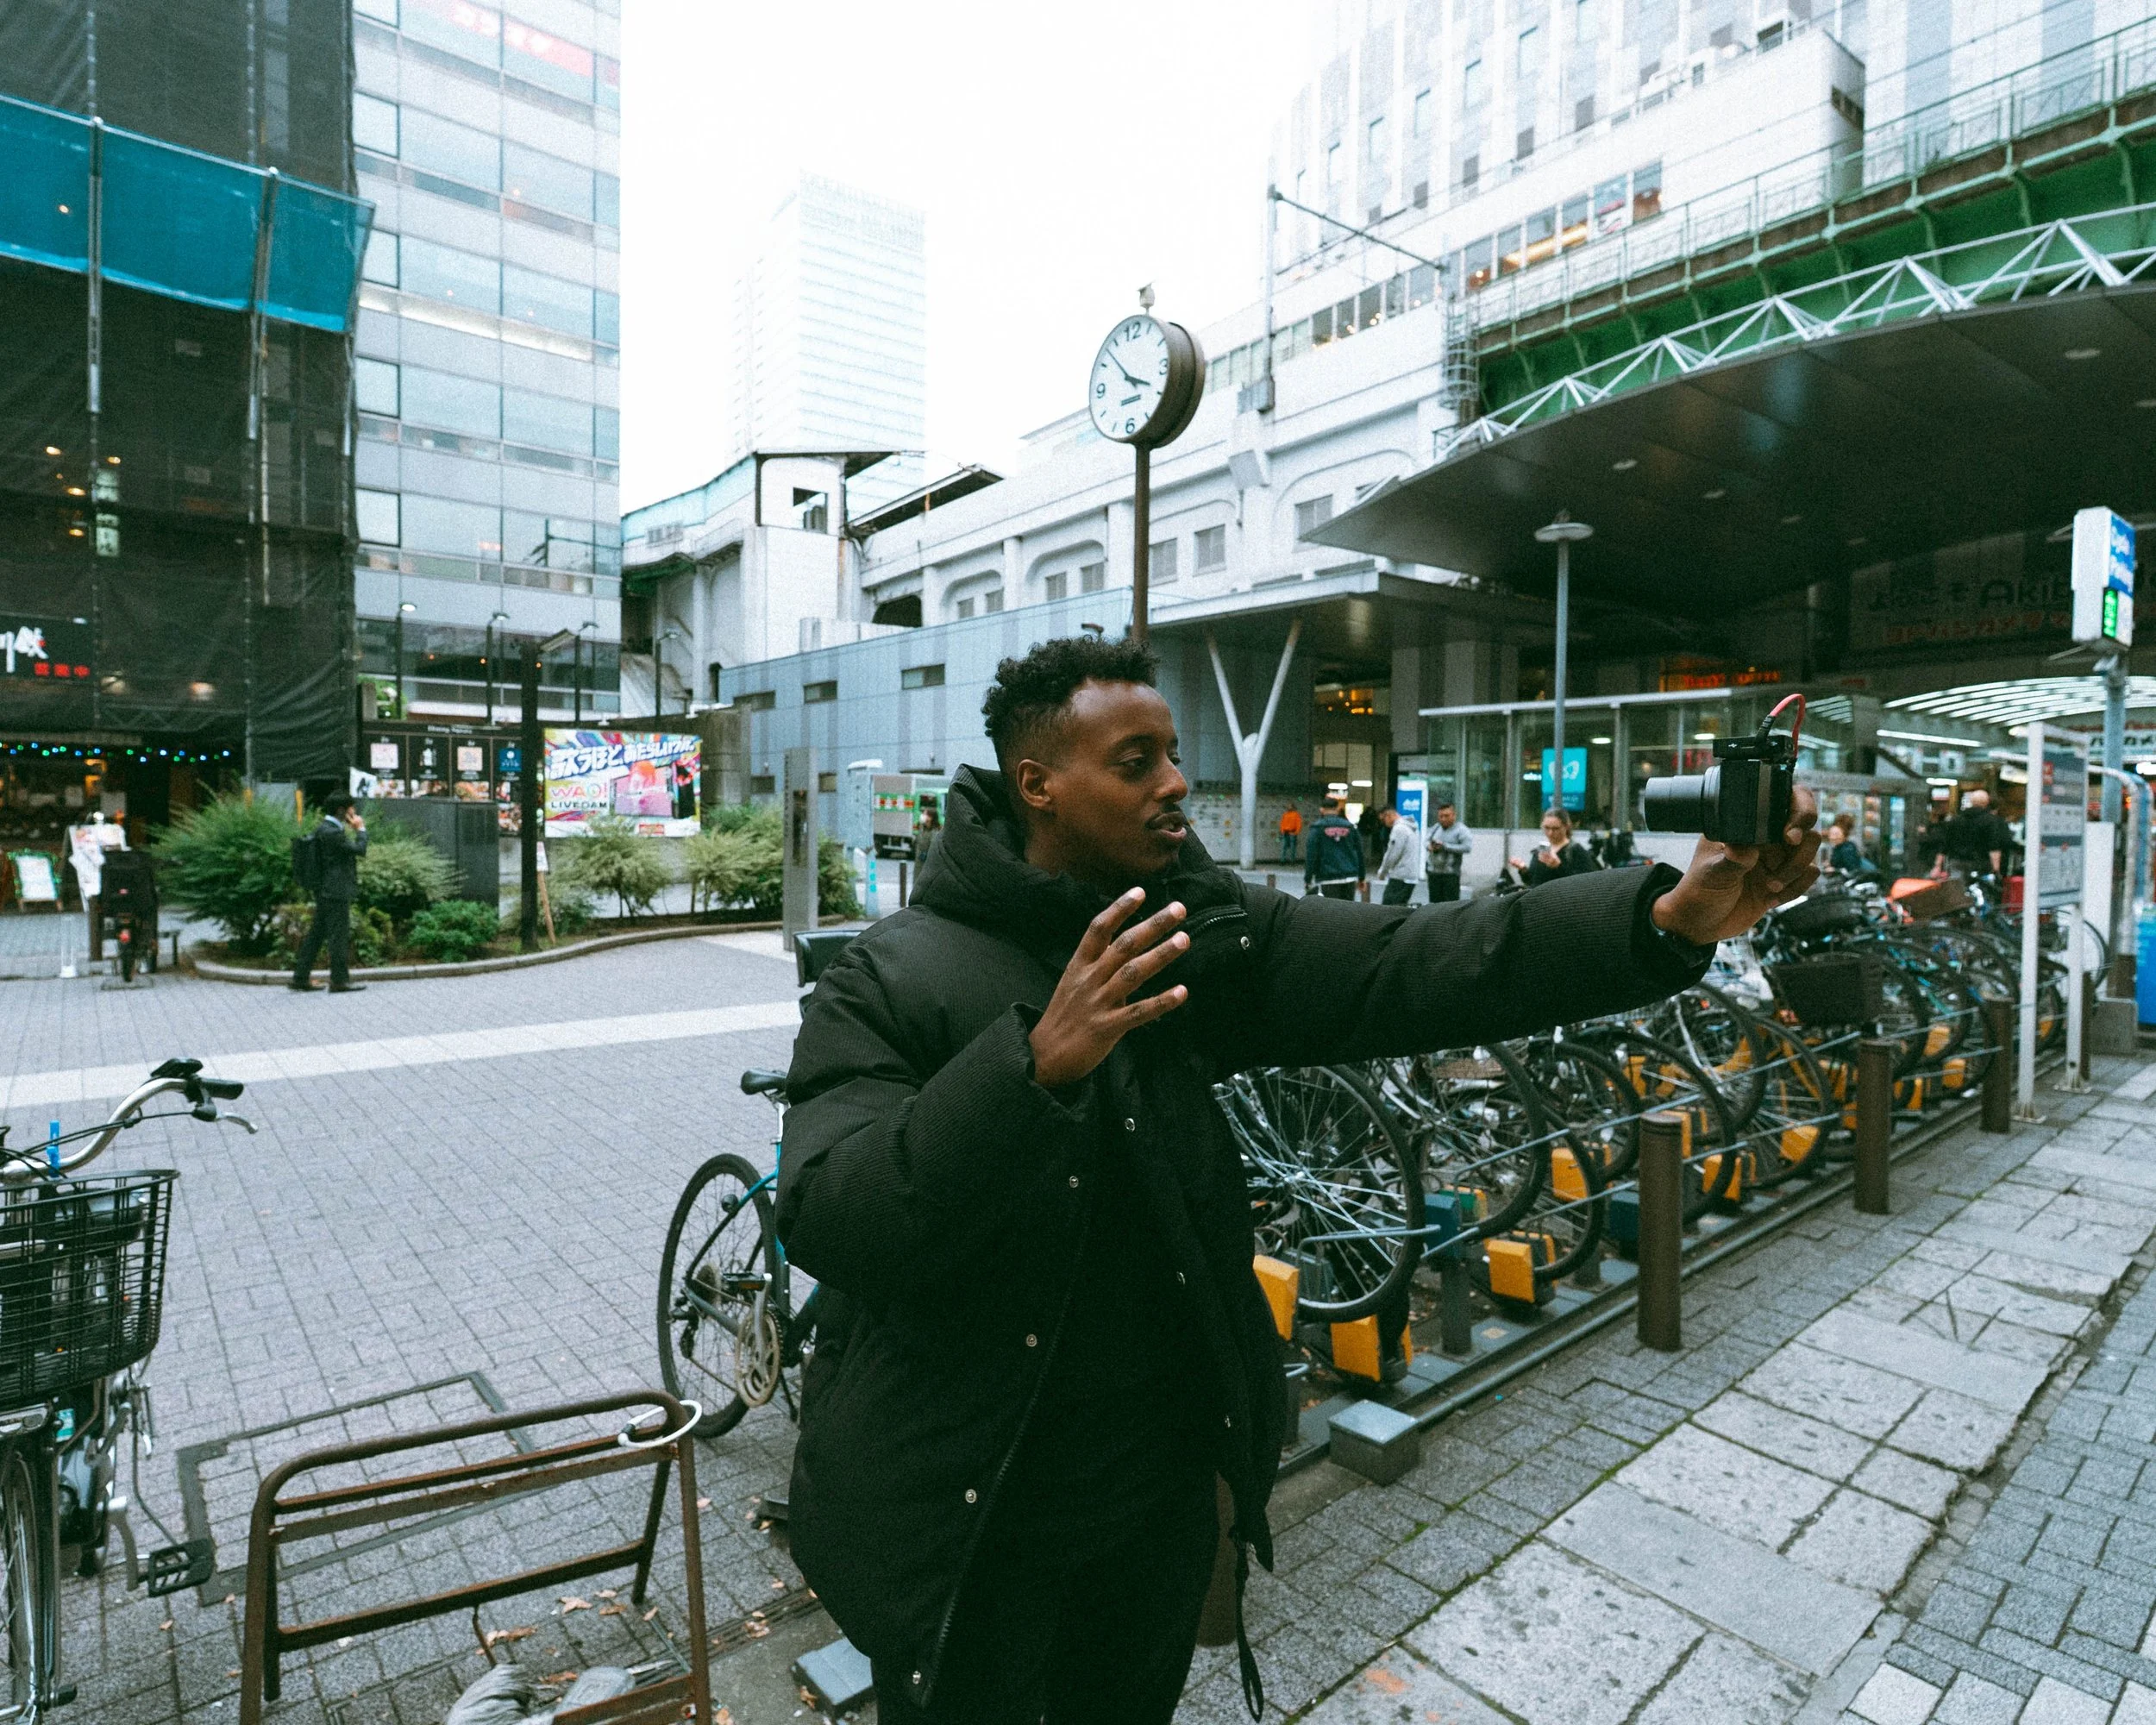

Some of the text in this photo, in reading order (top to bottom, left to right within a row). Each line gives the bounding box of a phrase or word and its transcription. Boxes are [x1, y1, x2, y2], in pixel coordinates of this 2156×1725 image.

[1124, 322, 1141, 342] 12
[1159, 358, 1169, 375] 3
[1095, 383, 1106, 398] 9
[1125, 418, 1135, 434] 6
